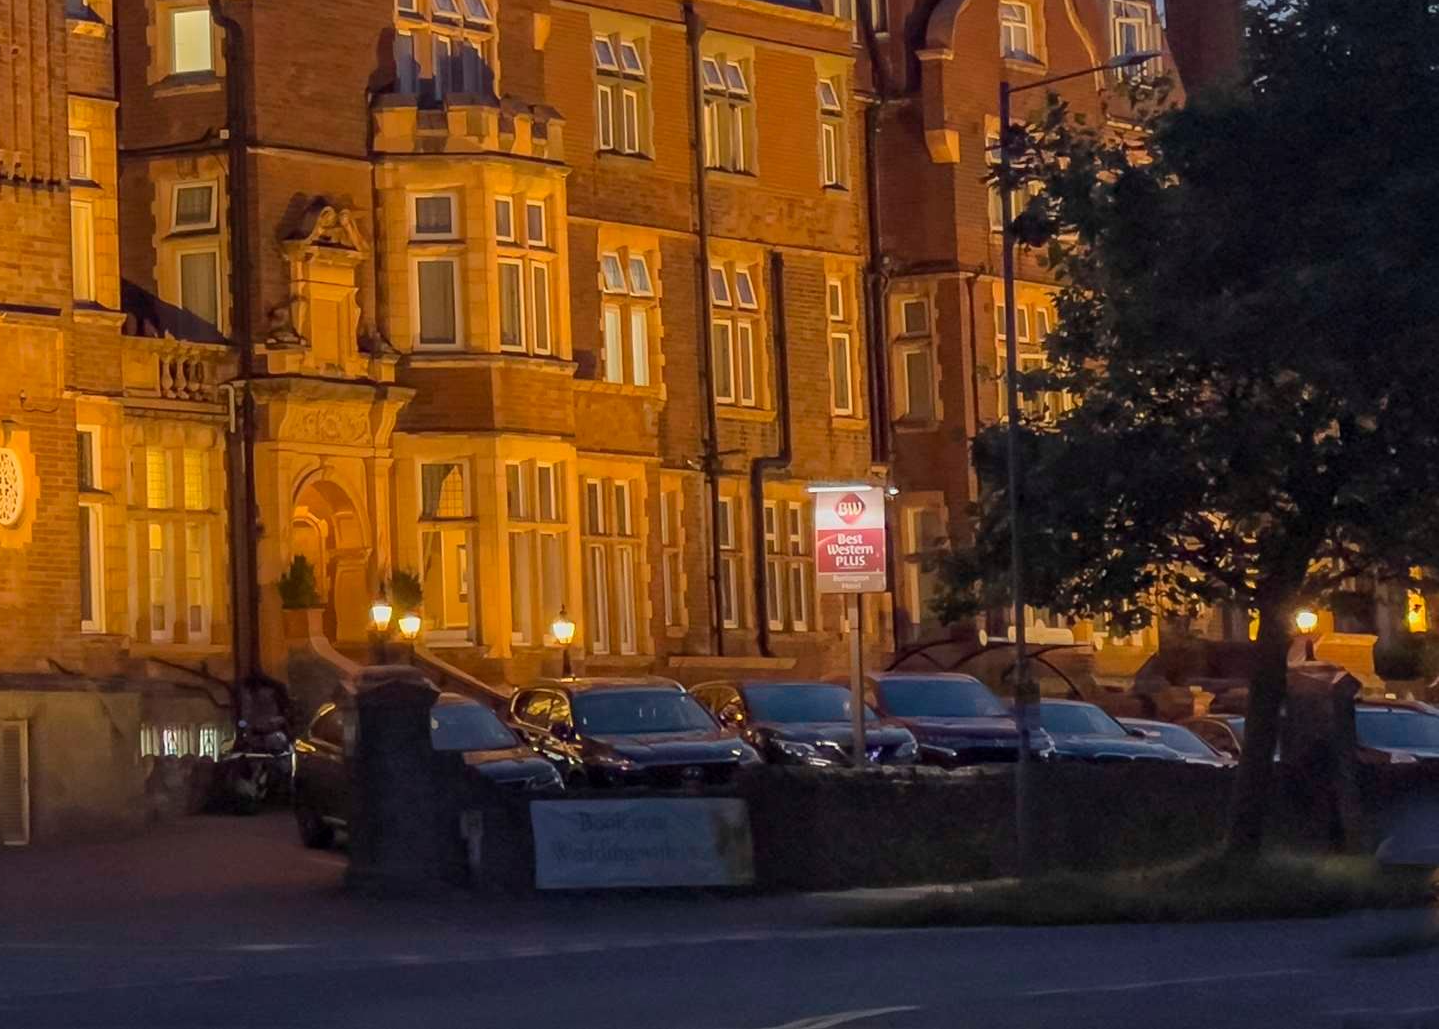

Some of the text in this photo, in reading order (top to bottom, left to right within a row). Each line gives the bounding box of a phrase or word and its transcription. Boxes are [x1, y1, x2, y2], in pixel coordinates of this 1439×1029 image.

[838, 501, 863, 516] BW
[837, 532, 863, 545] Best
[827, 543, 874, 555] Western
[835, 555, 866, 567] PLUS
